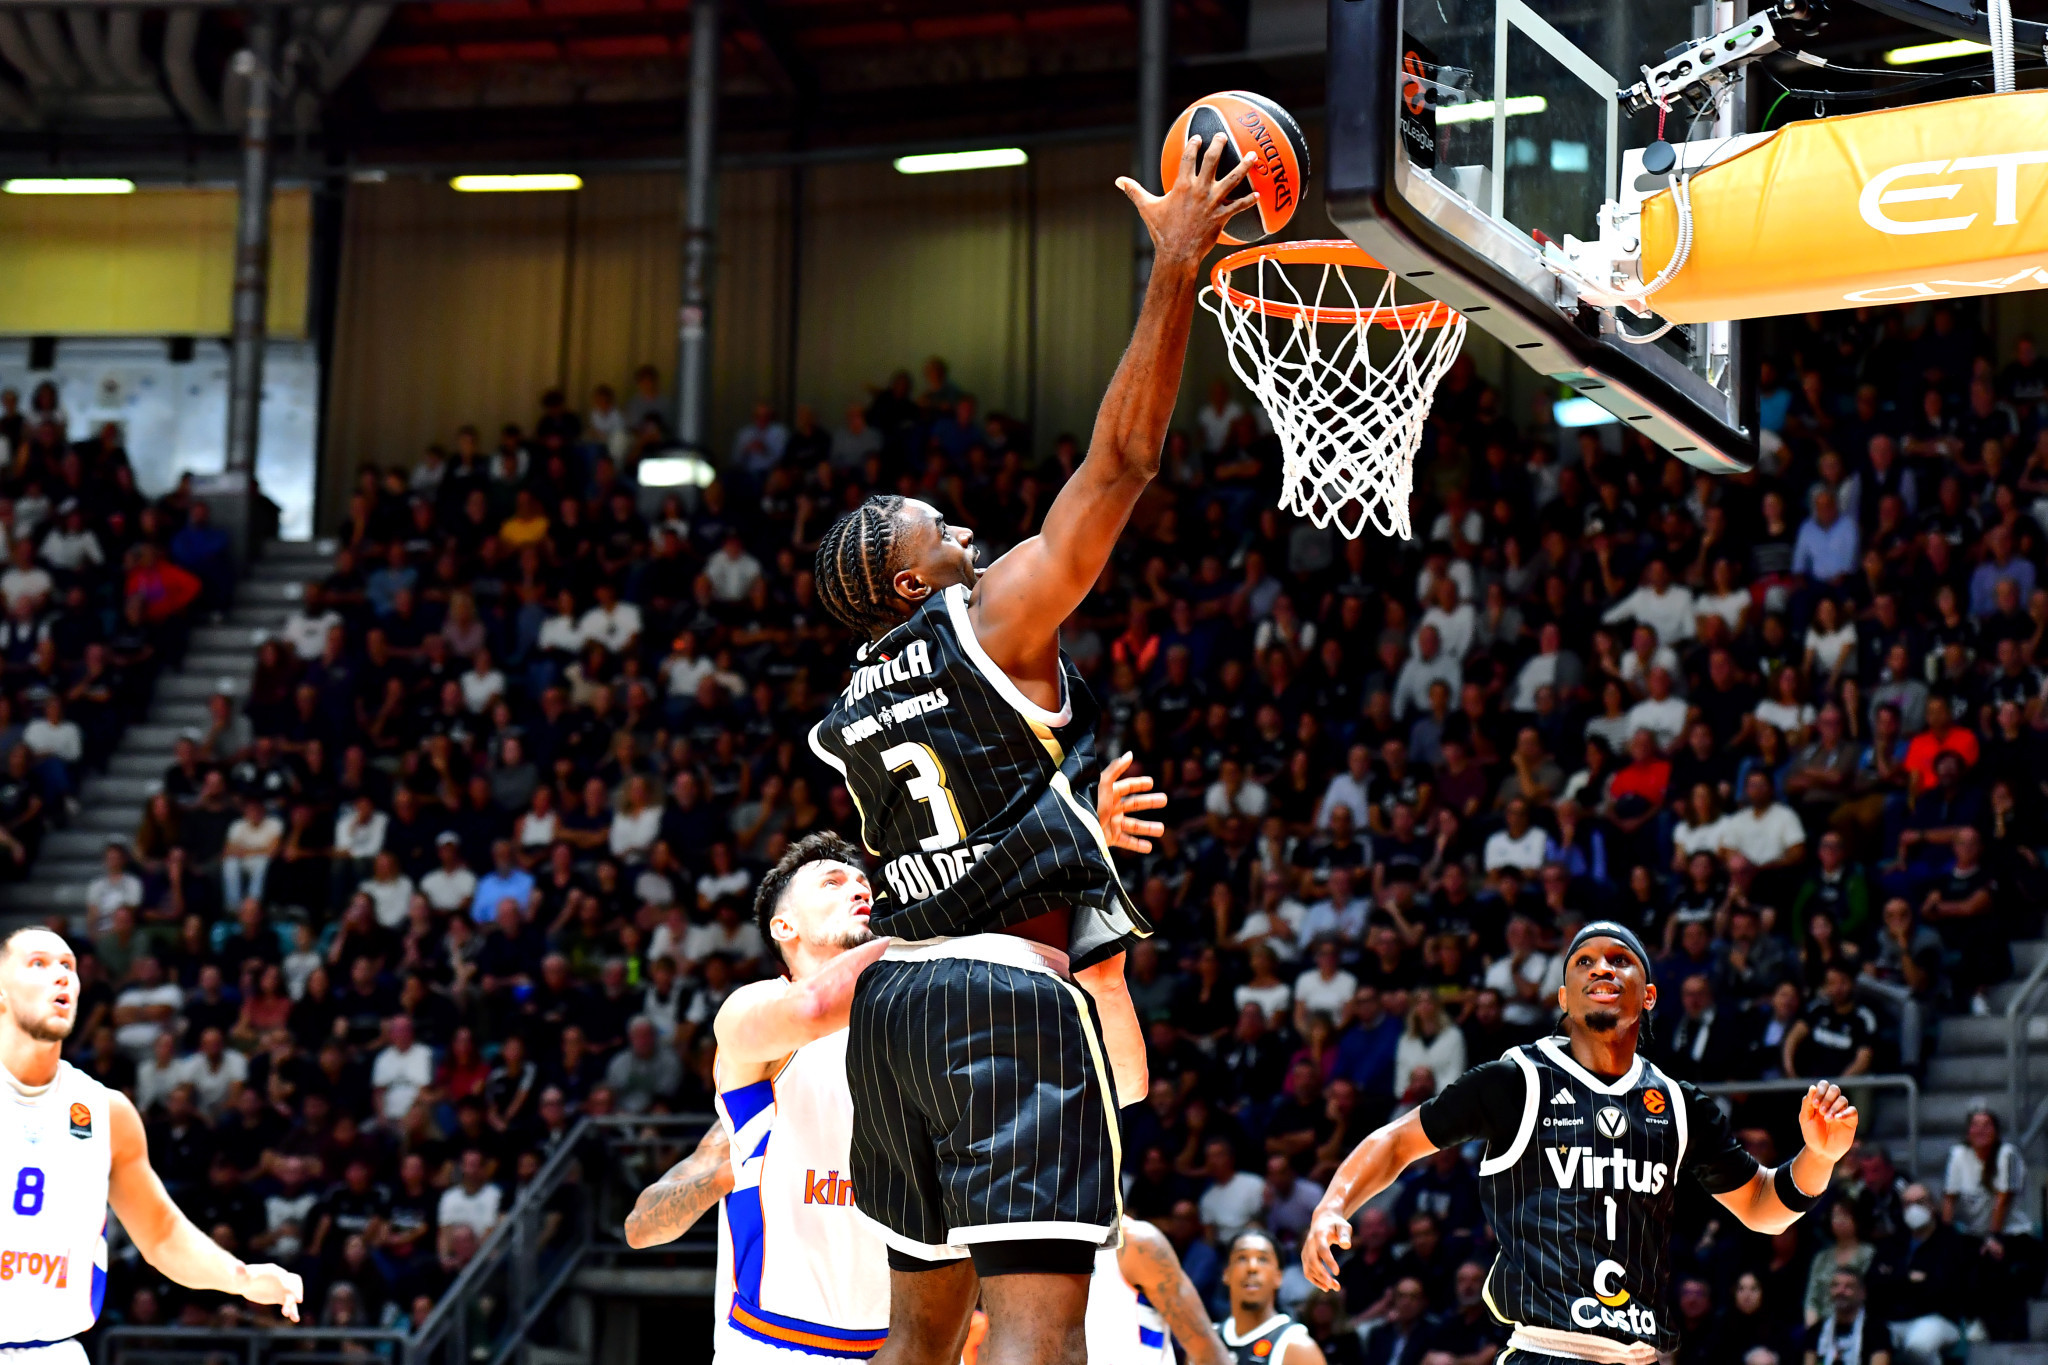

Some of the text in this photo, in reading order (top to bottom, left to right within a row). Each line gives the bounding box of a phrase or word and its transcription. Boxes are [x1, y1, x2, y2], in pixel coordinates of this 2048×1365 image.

[1238, 111, 1293, 213] SPALDING
[880, 742, 966, 852] 3
[1552, 1117, 1584, 1127] Pelliconi
[1645, 1117, 1669, 1125] ETIHAD
[13, 1166, 45, 1216] 8
[1544, 1147, 1668, 1195] Virtus
[1604, 1196, 1617, 1241] 1
[1570, 1297, 1657, 1335] Costa
